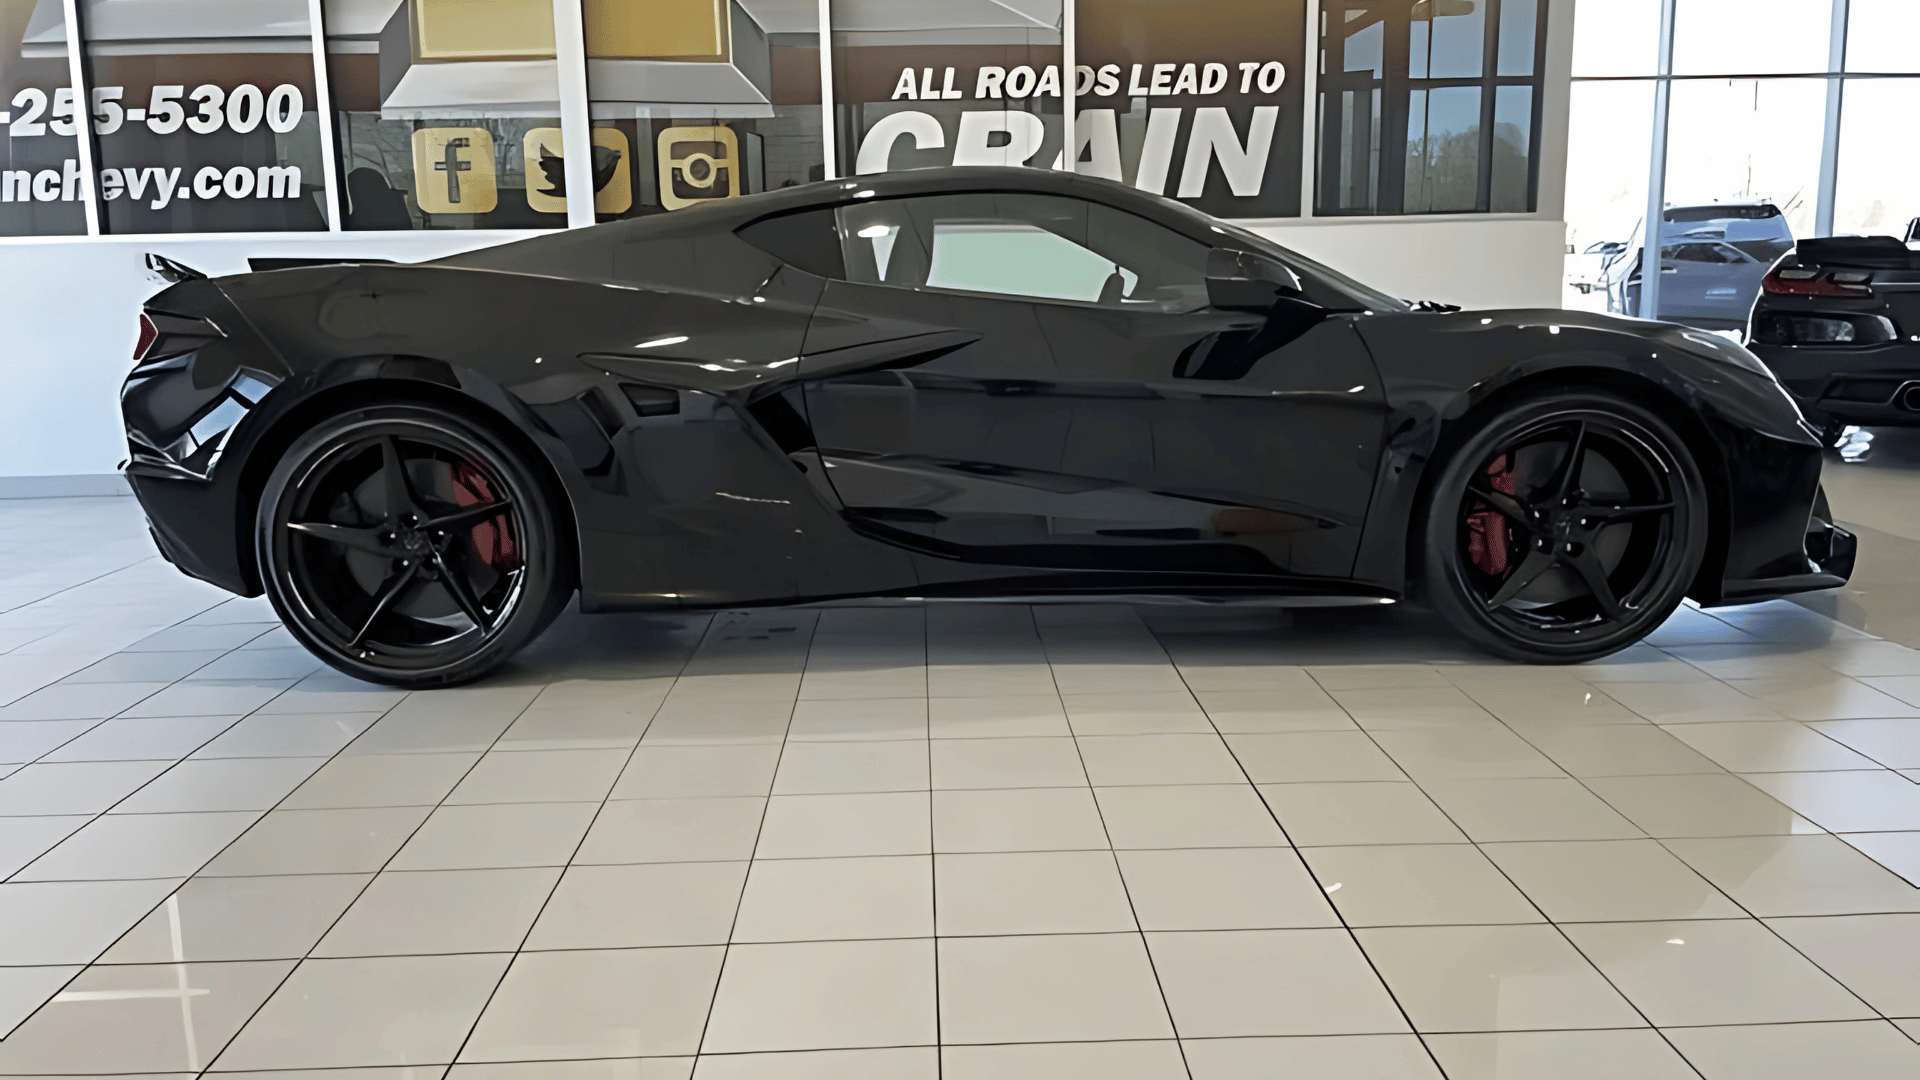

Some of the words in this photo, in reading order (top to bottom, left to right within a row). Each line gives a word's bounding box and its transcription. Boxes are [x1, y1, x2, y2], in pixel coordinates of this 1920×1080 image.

[891, 67, 962, 100] ALL
[975, 64, 1120, 99] ROADS
[1128, 63, 1228, 96] LEAD
[1238, 61, 1286, 94] TO
[855, 106, 1279, 198] CRAIN
